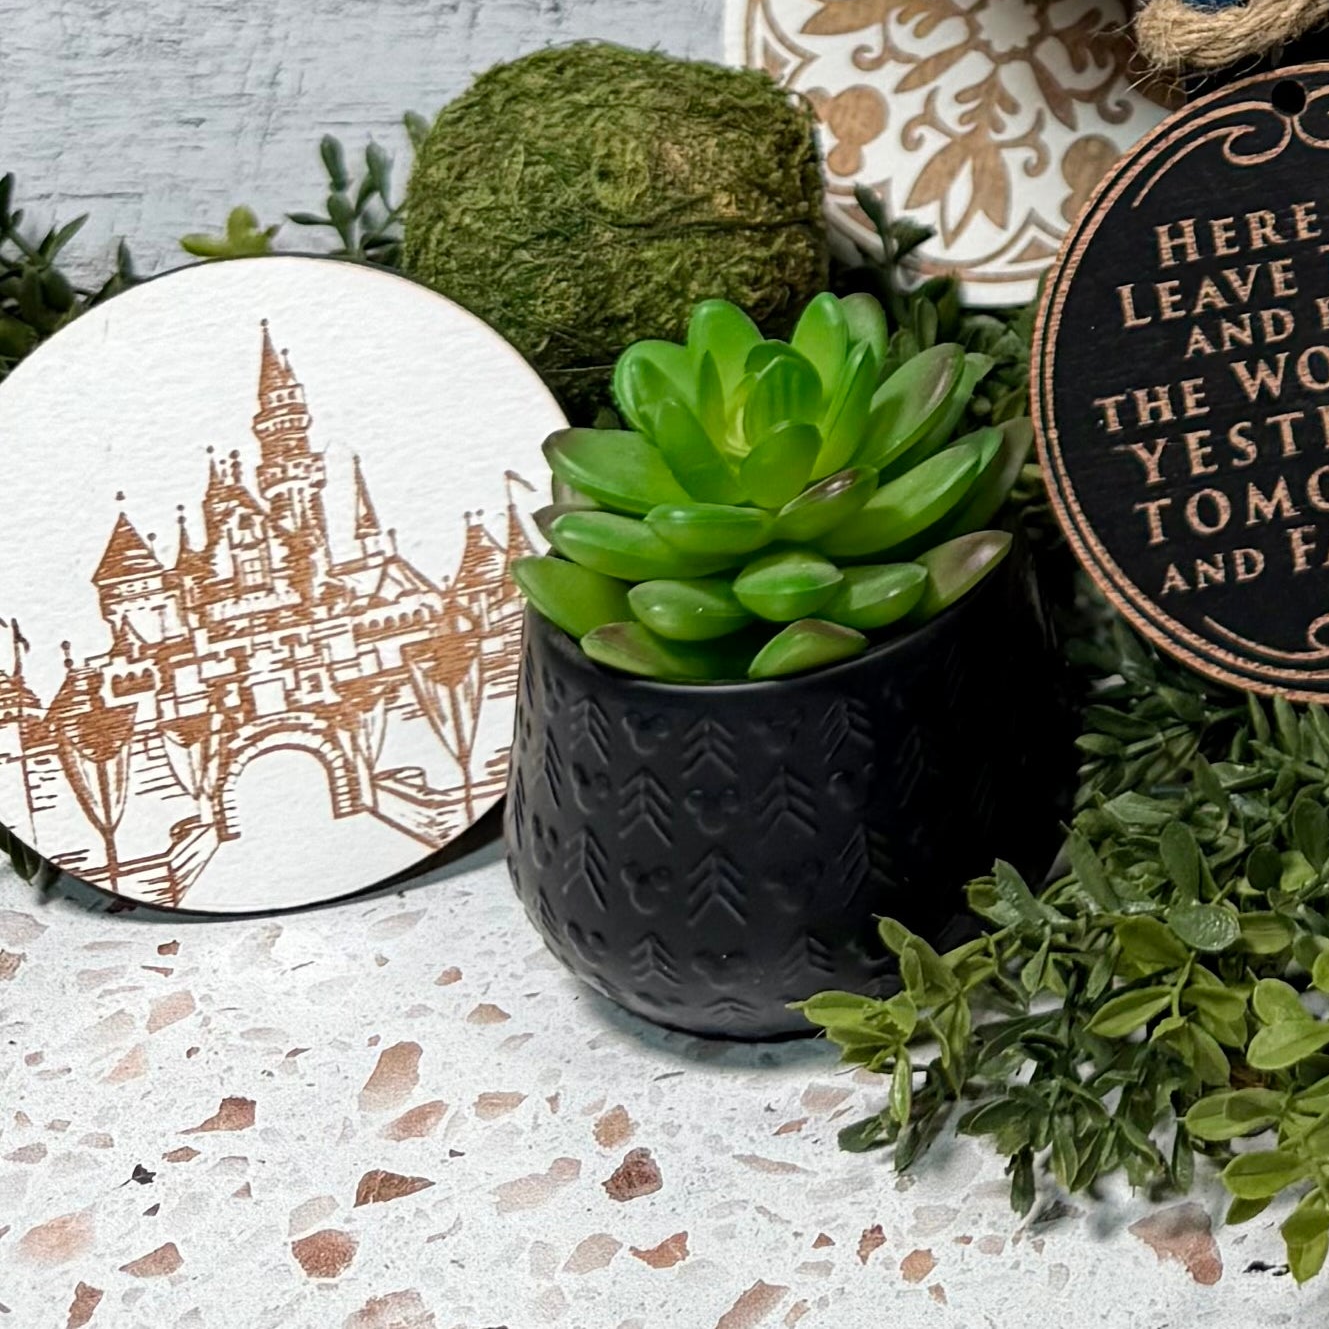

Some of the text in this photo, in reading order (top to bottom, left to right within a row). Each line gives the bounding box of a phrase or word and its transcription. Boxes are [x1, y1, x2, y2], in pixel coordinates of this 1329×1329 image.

[1155, 201, 1322, 269] HERE
[1117, 258, 1298, 329] LEAVE
[1184, 307, 1296, 360] AND
[1094, 376, 1211, 434] THE
[1161, 546, 1266, 596] AND
